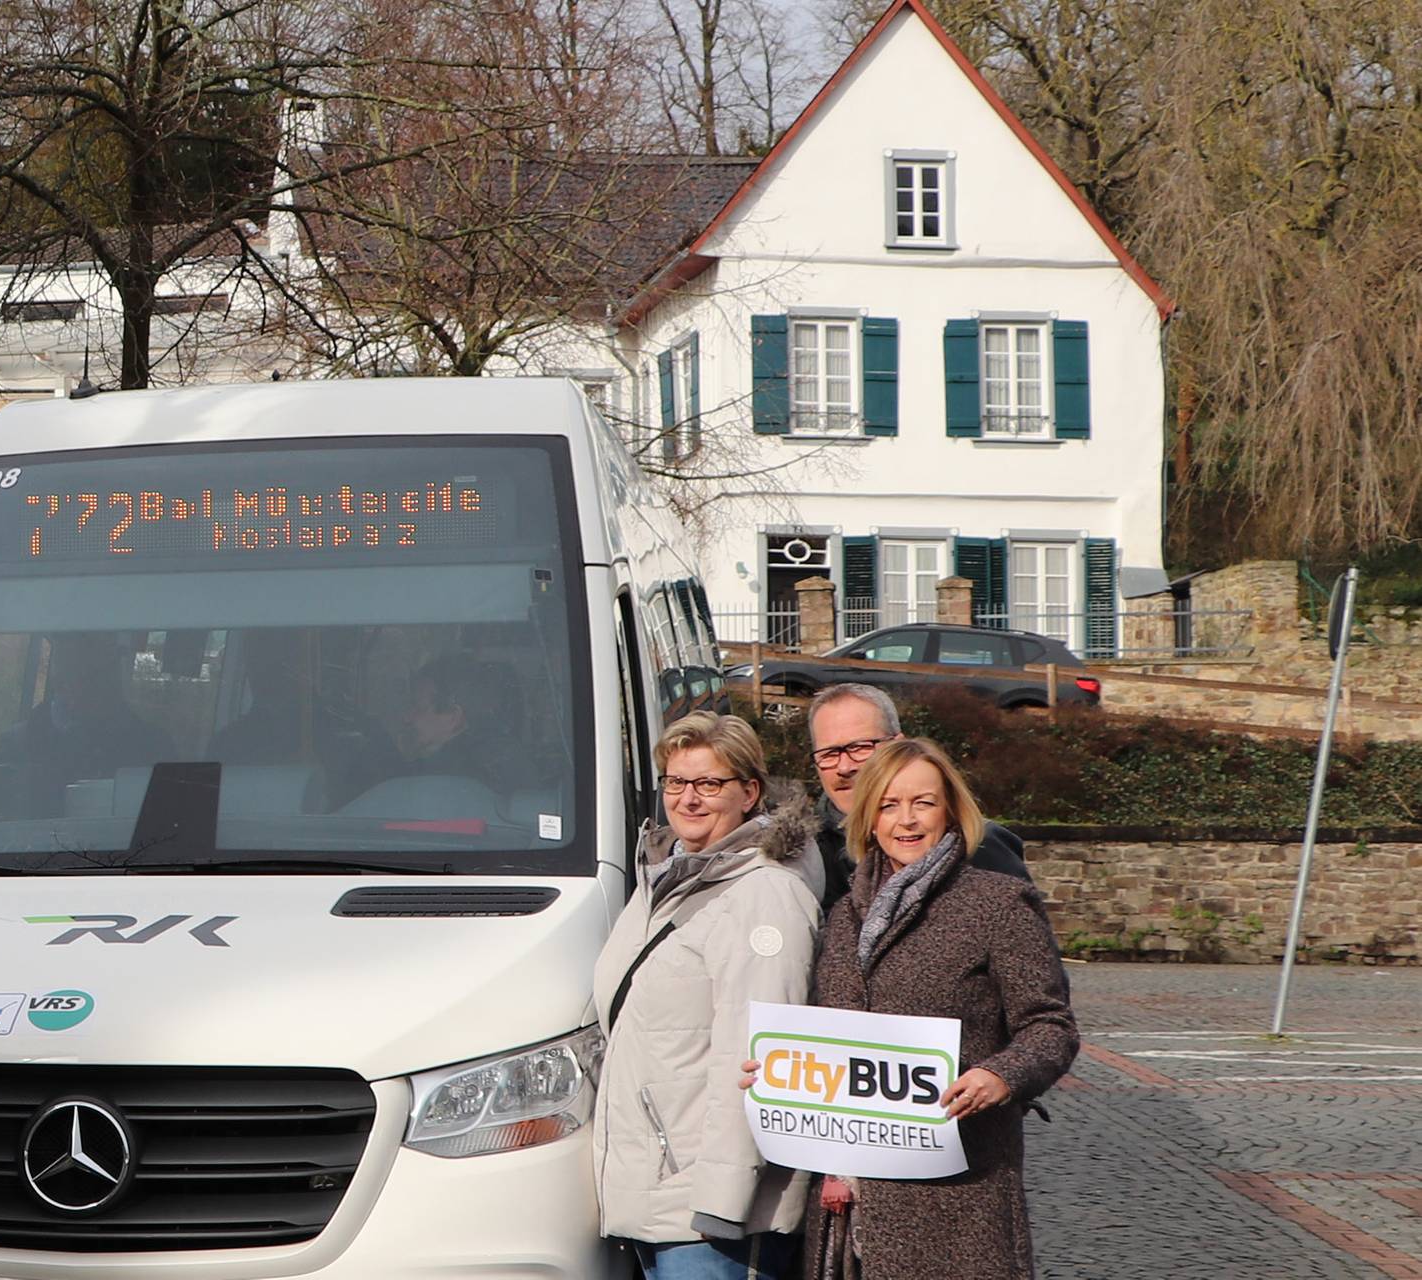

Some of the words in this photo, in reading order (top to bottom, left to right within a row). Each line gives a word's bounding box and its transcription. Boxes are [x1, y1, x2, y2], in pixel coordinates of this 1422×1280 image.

[29, 997, 81, 1010] VRS
[763, 1049, 940, 1105] CityBUS
[759, 1108, 797, 1132] BAD
[800, 1112, 944, 1149] MÜNSTEREIFEL
